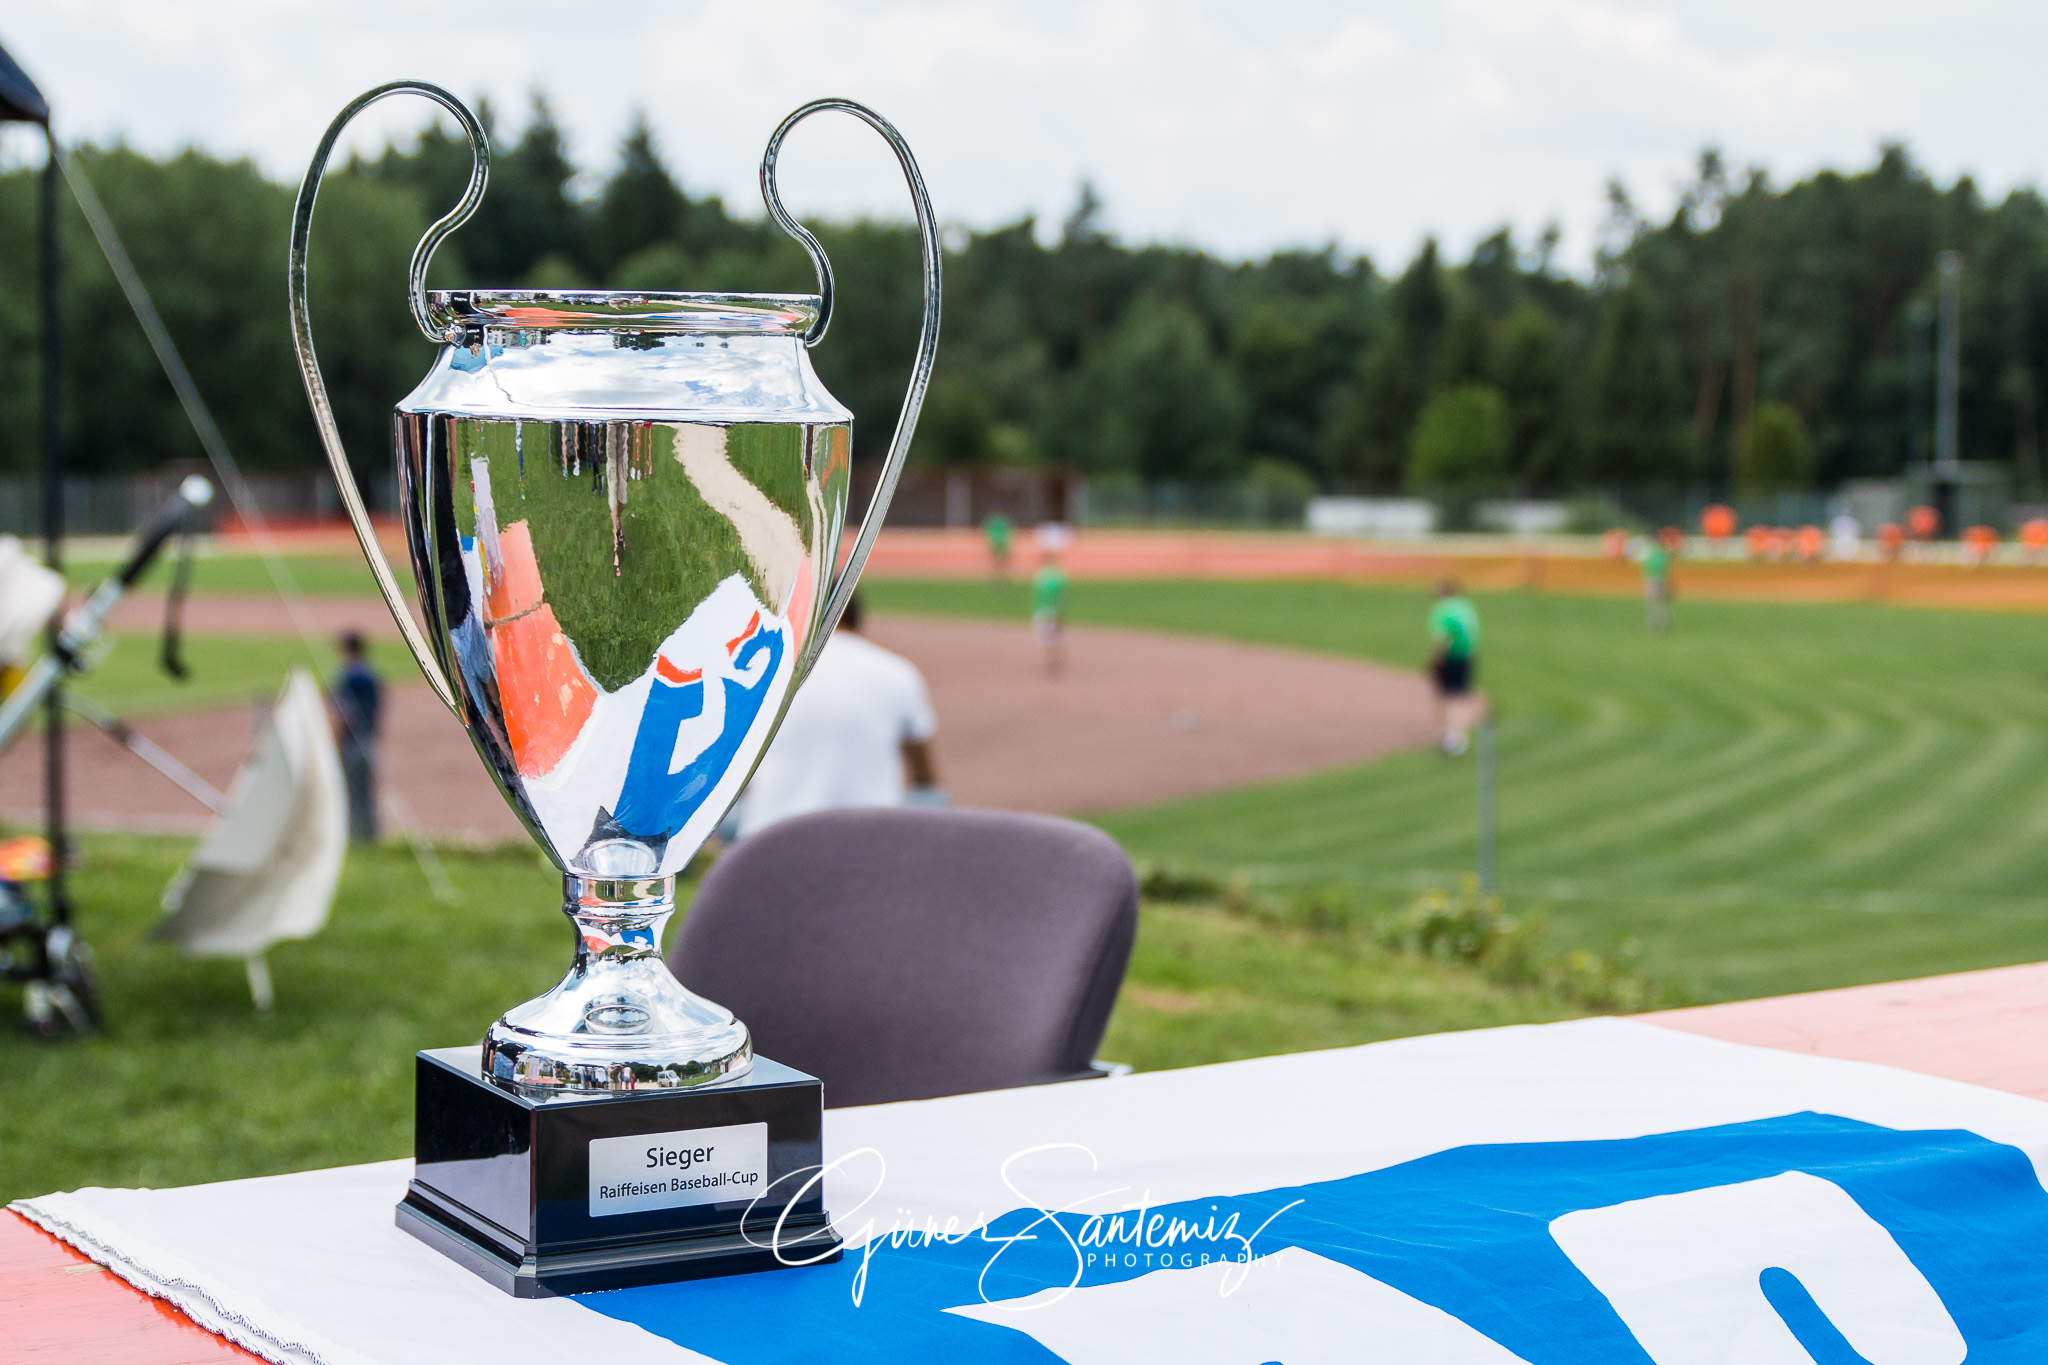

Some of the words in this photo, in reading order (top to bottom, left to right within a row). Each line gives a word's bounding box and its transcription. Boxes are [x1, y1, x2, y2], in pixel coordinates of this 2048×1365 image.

[646, 1146, 715, 1170] Sieger
[599, 1182, 667, 1199] Raiffeisen
[671, 1171, 759, 1191] Baseball-Cup
